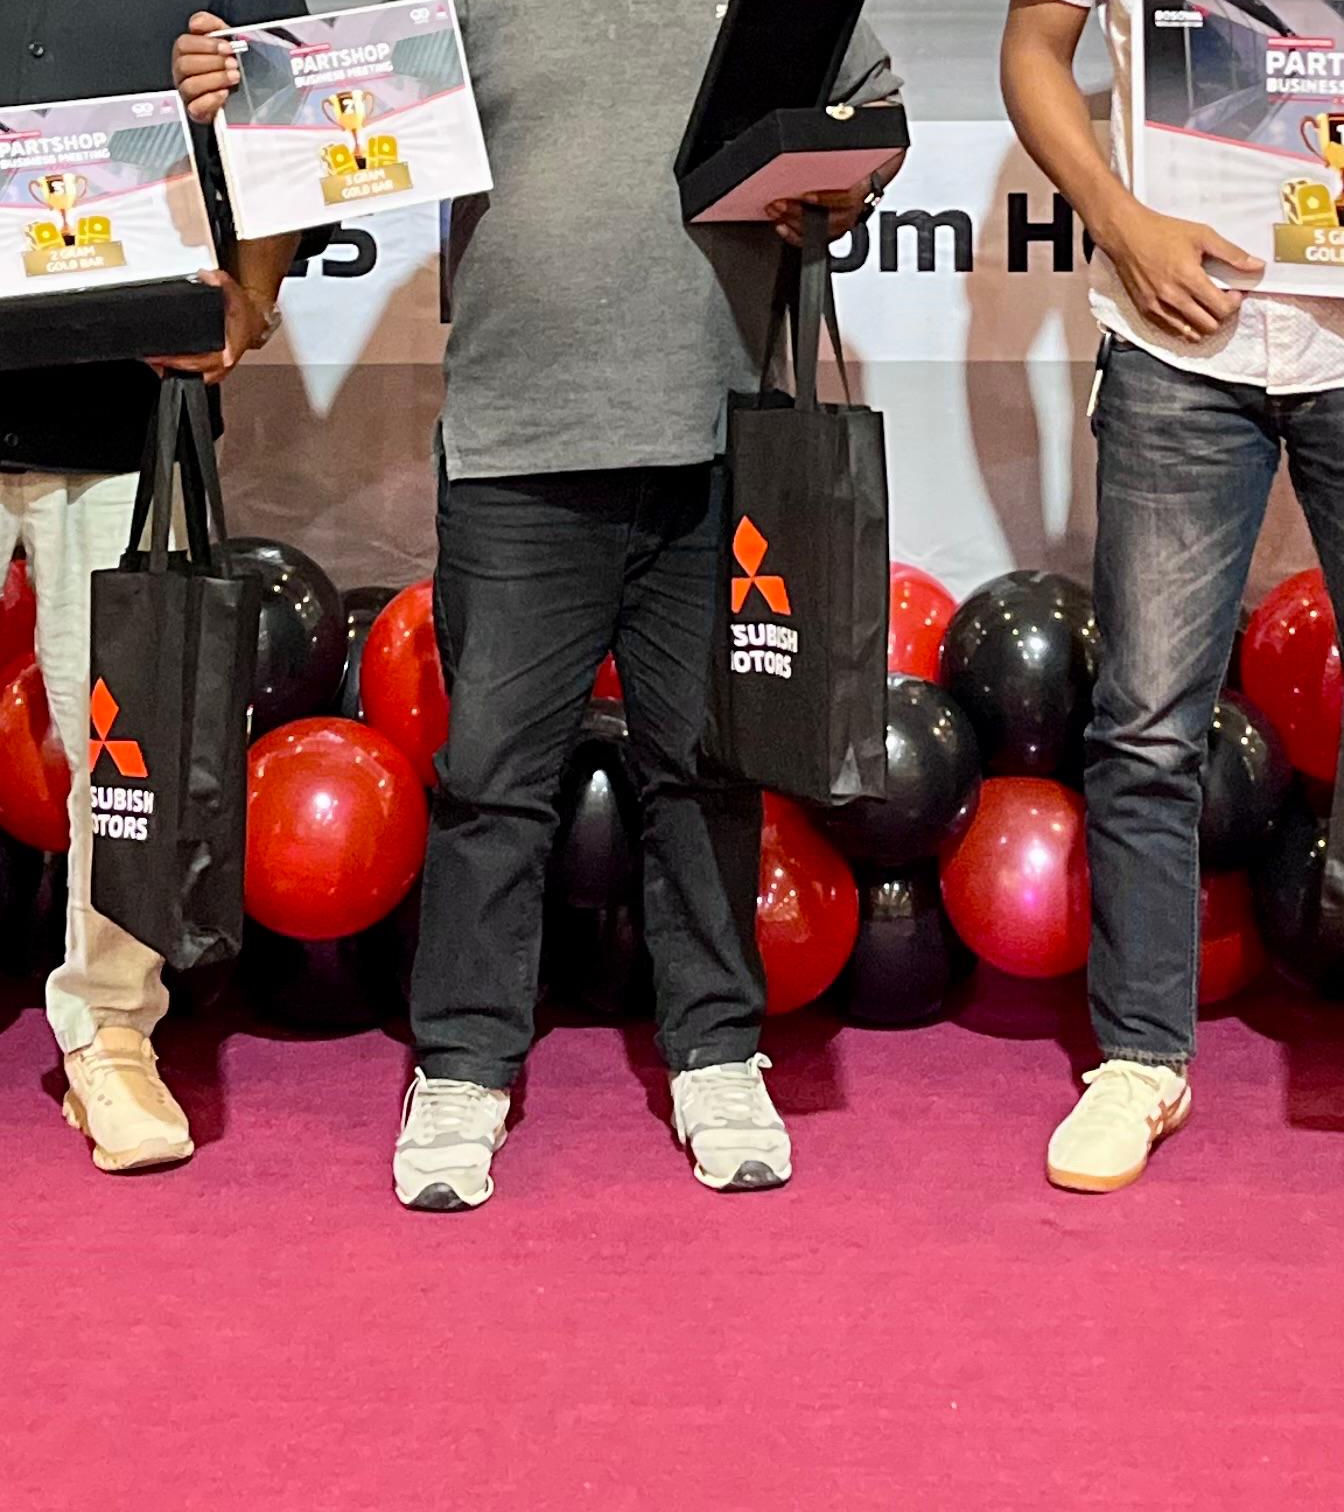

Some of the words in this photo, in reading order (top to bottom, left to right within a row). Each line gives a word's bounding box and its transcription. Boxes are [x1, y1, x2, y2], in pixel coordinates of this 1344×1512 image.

[290, 43, 390, 75] PARTSHOP
[1008, 192, 1095, 272] H
[1314, 229, 1325, 244] 5
[730, 623, 798, 653] SUBISH
[730, 650, 792, 679] OTORS
